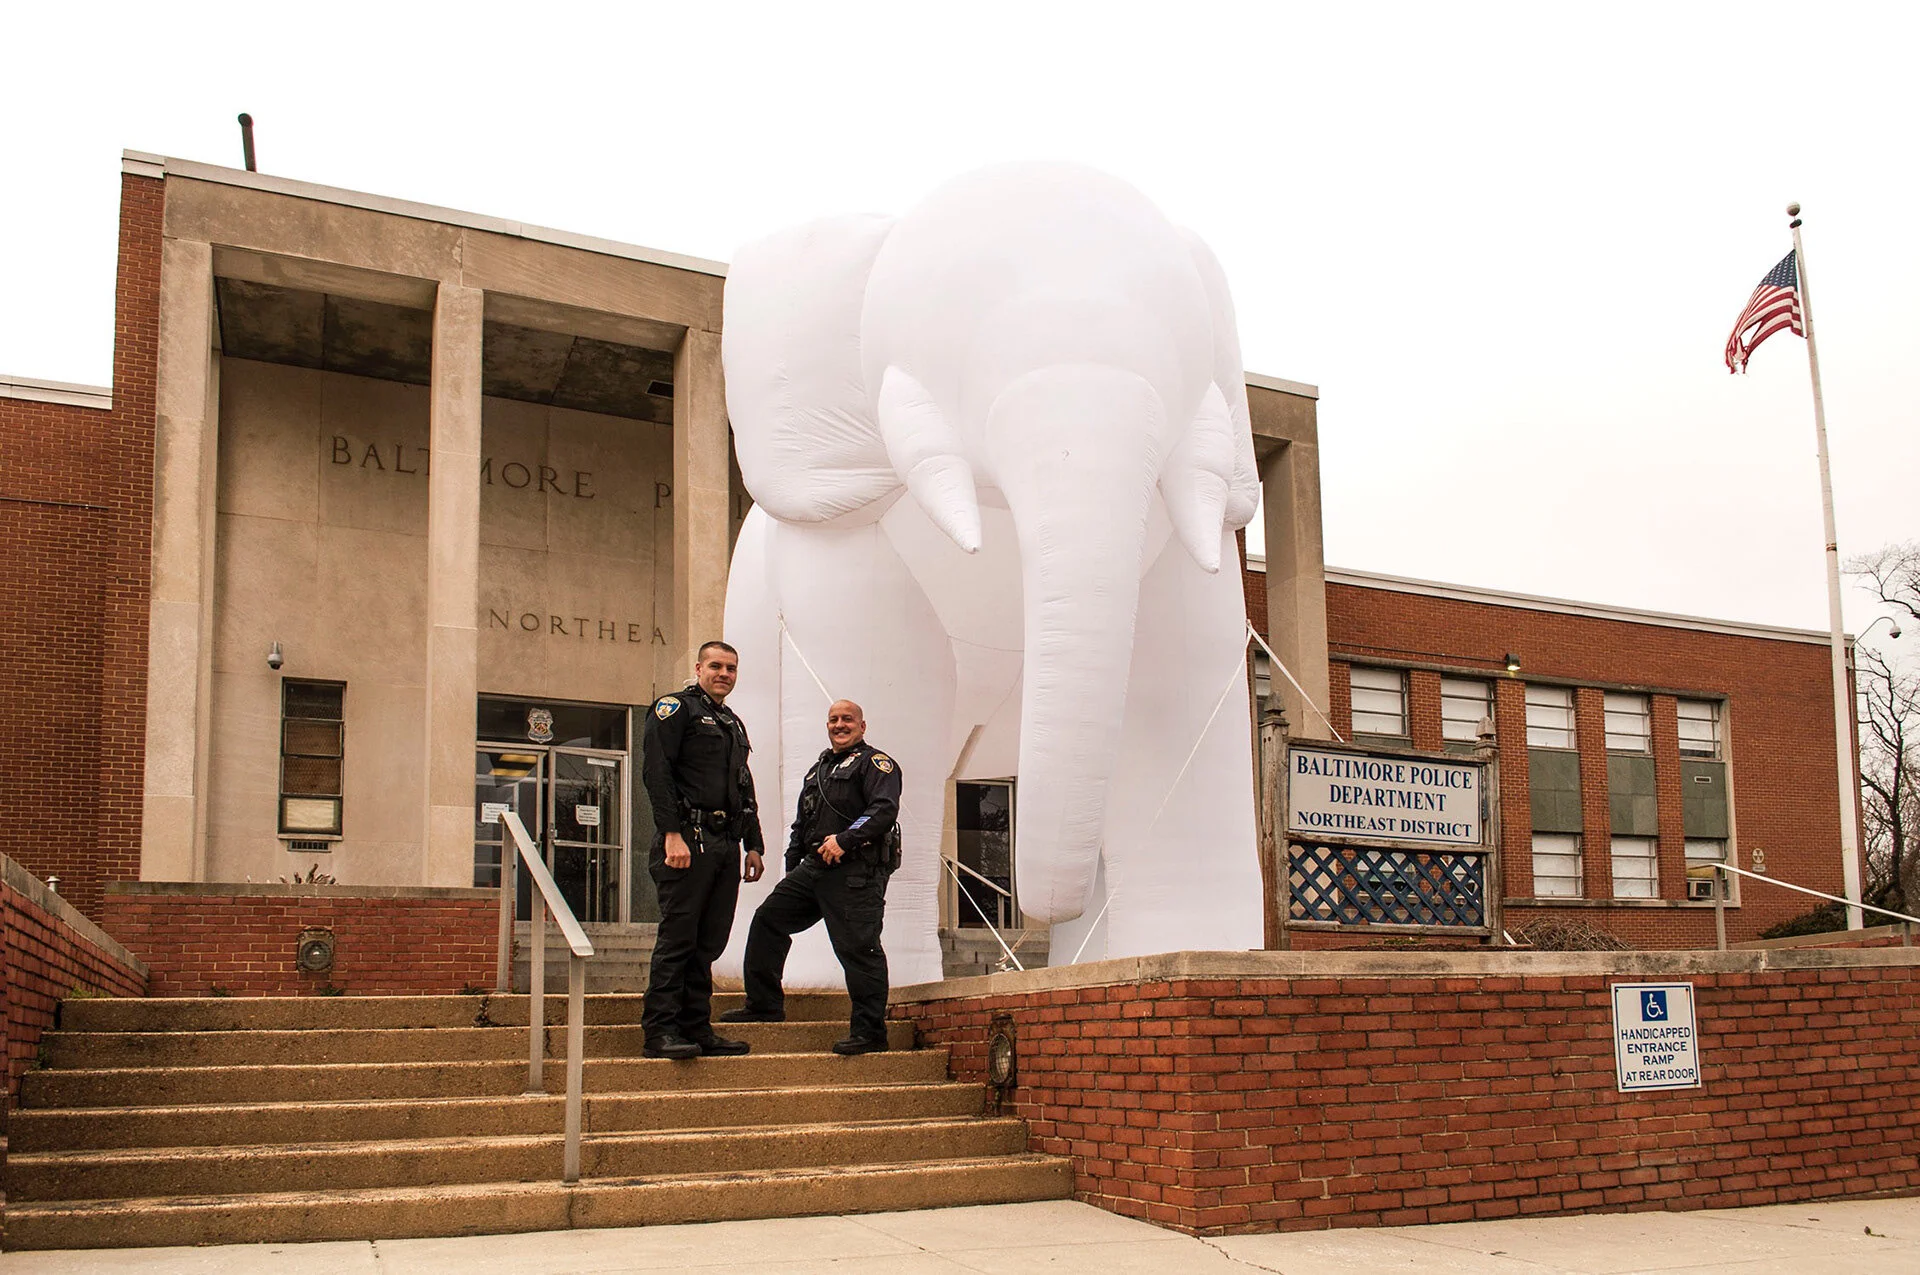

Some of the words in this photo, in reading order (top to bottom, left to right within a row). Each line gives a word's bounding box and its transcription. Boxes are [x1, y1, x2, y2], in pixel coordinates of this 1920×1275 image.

[332, 435, 596, 499] BALTMORE
[490, 608, 667, 645] NORTHEA
[1297, 755, 1405, 783] BALTIMORE
[1410, 766, 1472, 789] POLICE
[1329, 784, 1447, 812] DEPARTMENT
[1298, 811, 1396, 831] NORTHEAST
[1400, 819, 1472, 837] DISTRICT
[1621, 1027, 1691, 1040] HANDICAPPED
[1627, 1041, 1688, 1054] ENTRANCE
[1642, 1054, 1675, 1065] RAMP
[1625, 1071, 1637, 1082] AT
[1639, 1069, 1666, 1081] REAR
[1668, 1068, 1695, 1080] DOOR
